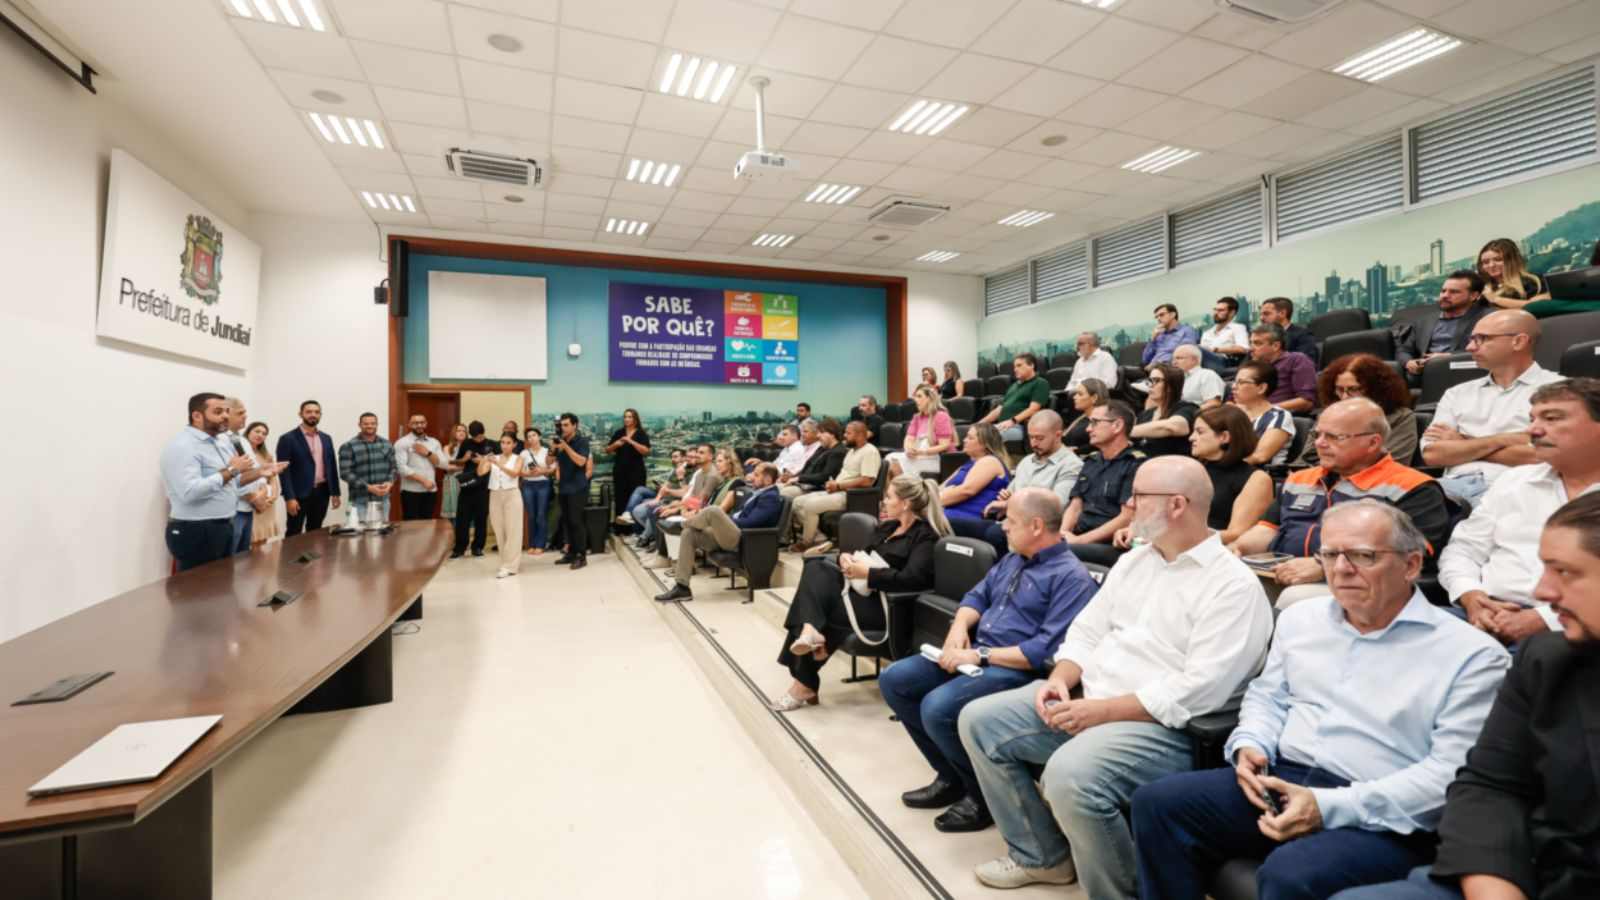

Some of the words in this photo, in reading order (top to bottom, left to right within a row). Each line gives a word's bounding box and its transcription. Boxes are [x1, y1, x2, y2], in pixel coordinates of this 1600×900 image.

[119, 277, 191, 327] Prefeitura
[193, 308, 209, 333] de
[644, 295, 693, 314] SABE
[622, 314, 659, 334] POR
[666, 315, 715, 337] QUÊ?
